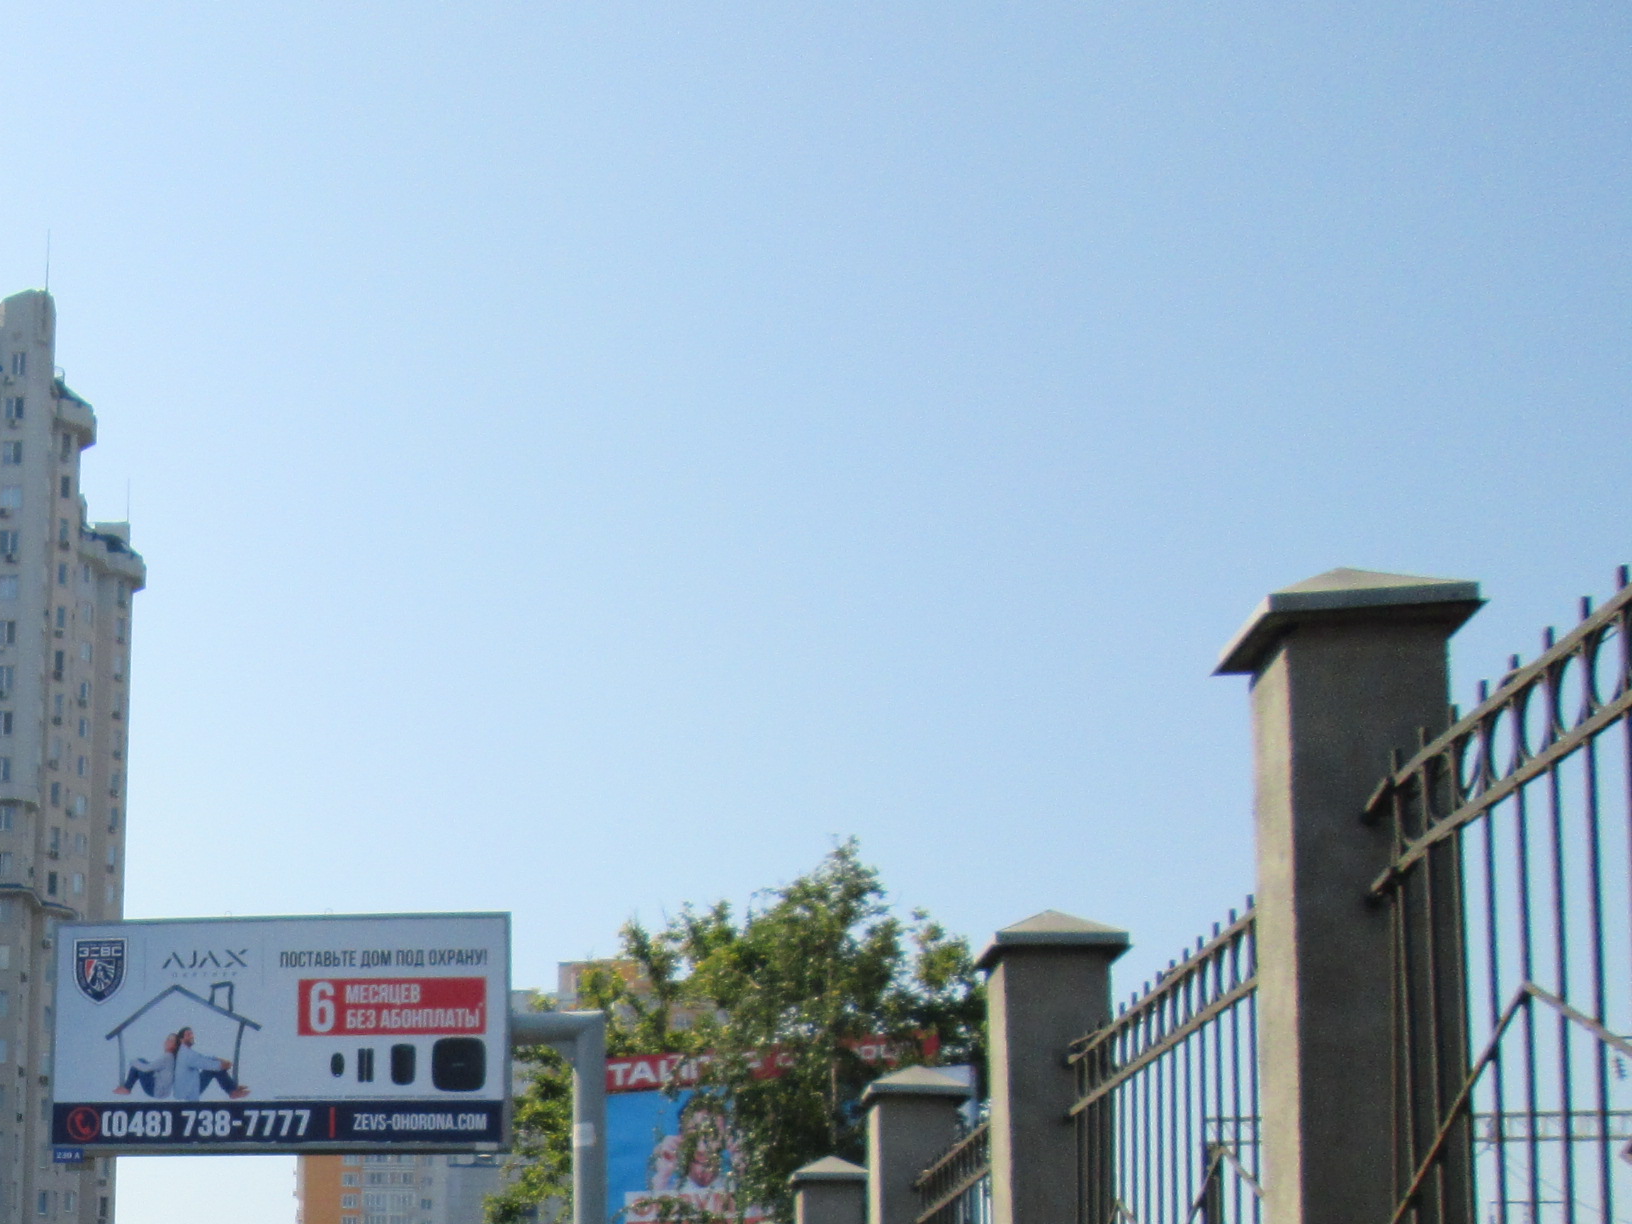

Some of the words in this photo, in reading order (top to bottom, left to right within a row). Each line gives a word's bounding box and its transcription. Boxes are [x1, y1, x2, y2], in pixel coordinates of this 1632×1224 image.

[162, 949, 248, 969] AJAX
[279, 950, 356, 968] ПОСТАВЬТЕ
[360, 950, 391, 968] ДОМ
[396, 950, 424, 967] ПОД
[429, 949, 488, 966] ОХРАНУ!
[345, 983, 421, 1005] МЕСЯЦЕВ
[309, 981, 335, 1032] 6
[345, 1009, 376, 1029] БЕЗ
[380, 1007, 481, 1029] АБОНПЛАТЫ
[101, 1110, 173, 1137] (048)
[181, 1108, 311, 1137] 738-7777
[353, 1113, 488, 1131] ZEVS-OHORONA.COM
